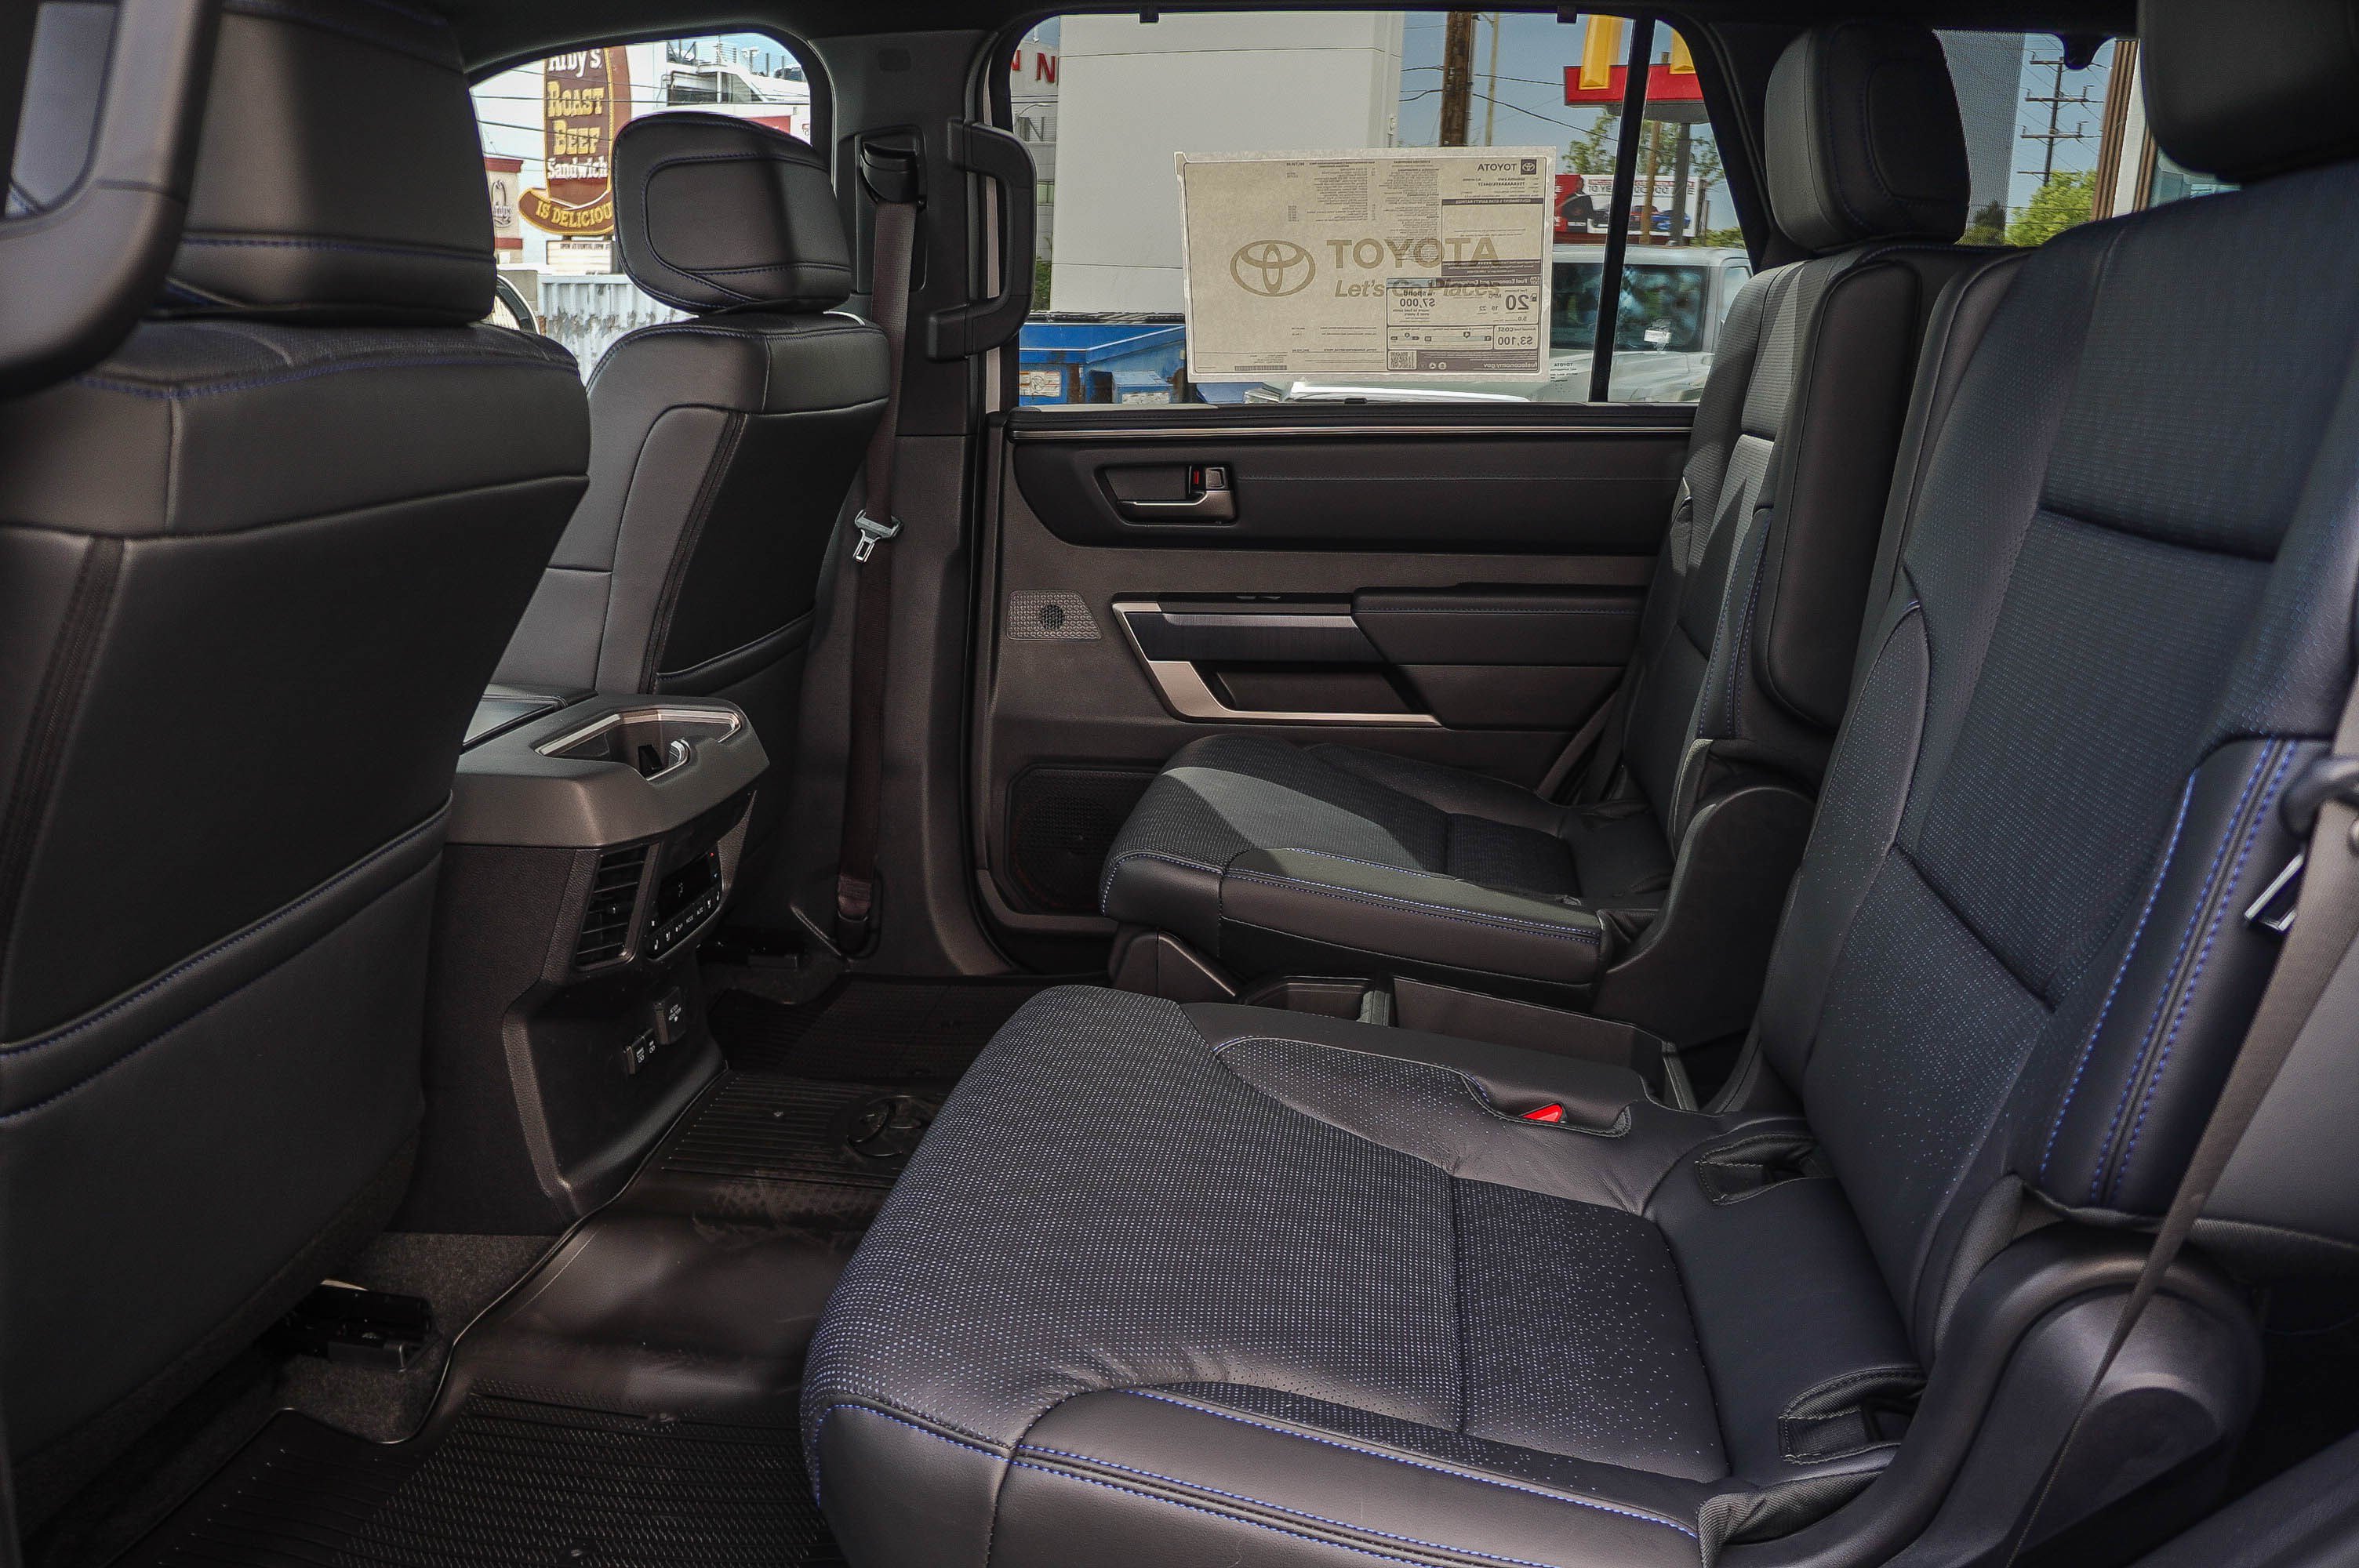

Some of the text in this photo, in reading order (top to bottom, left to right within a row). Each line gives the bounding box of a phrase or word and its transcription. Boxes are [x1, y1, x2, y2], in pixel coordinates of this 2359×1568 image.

[552, 118, 602, 155] BEEF
[547, 155, 609, 180] Sandwich
[535, 200, 613, 228] IS DELICIOU
[1326, 237, 1499, 269] TOYOTA
[1335, 279, 1385, 298] Let's
